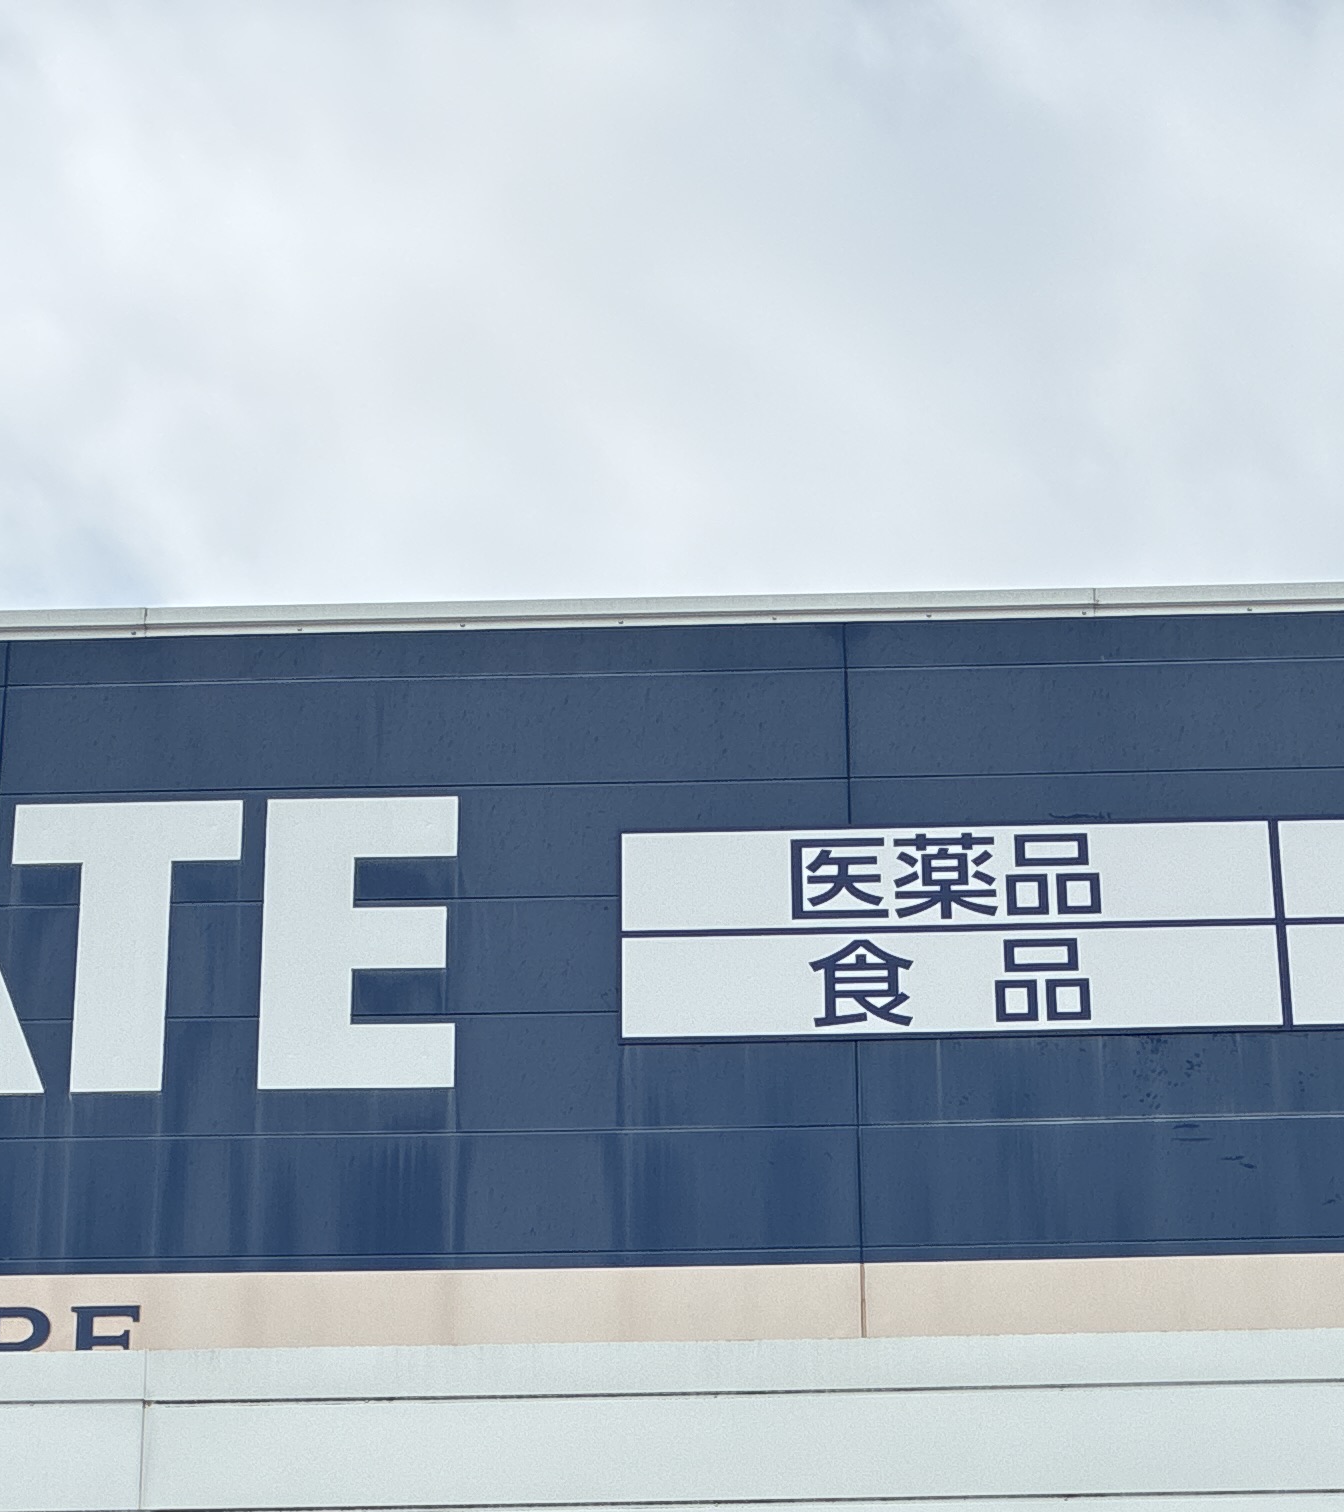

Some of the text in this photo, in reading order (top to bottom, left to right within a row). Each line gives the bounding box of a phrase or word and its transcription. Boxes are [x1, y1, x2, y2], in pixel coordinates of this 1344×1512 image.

[790, 832, 1102, 920] 医薬品
[808, 939, 1092, 1027] 食品
